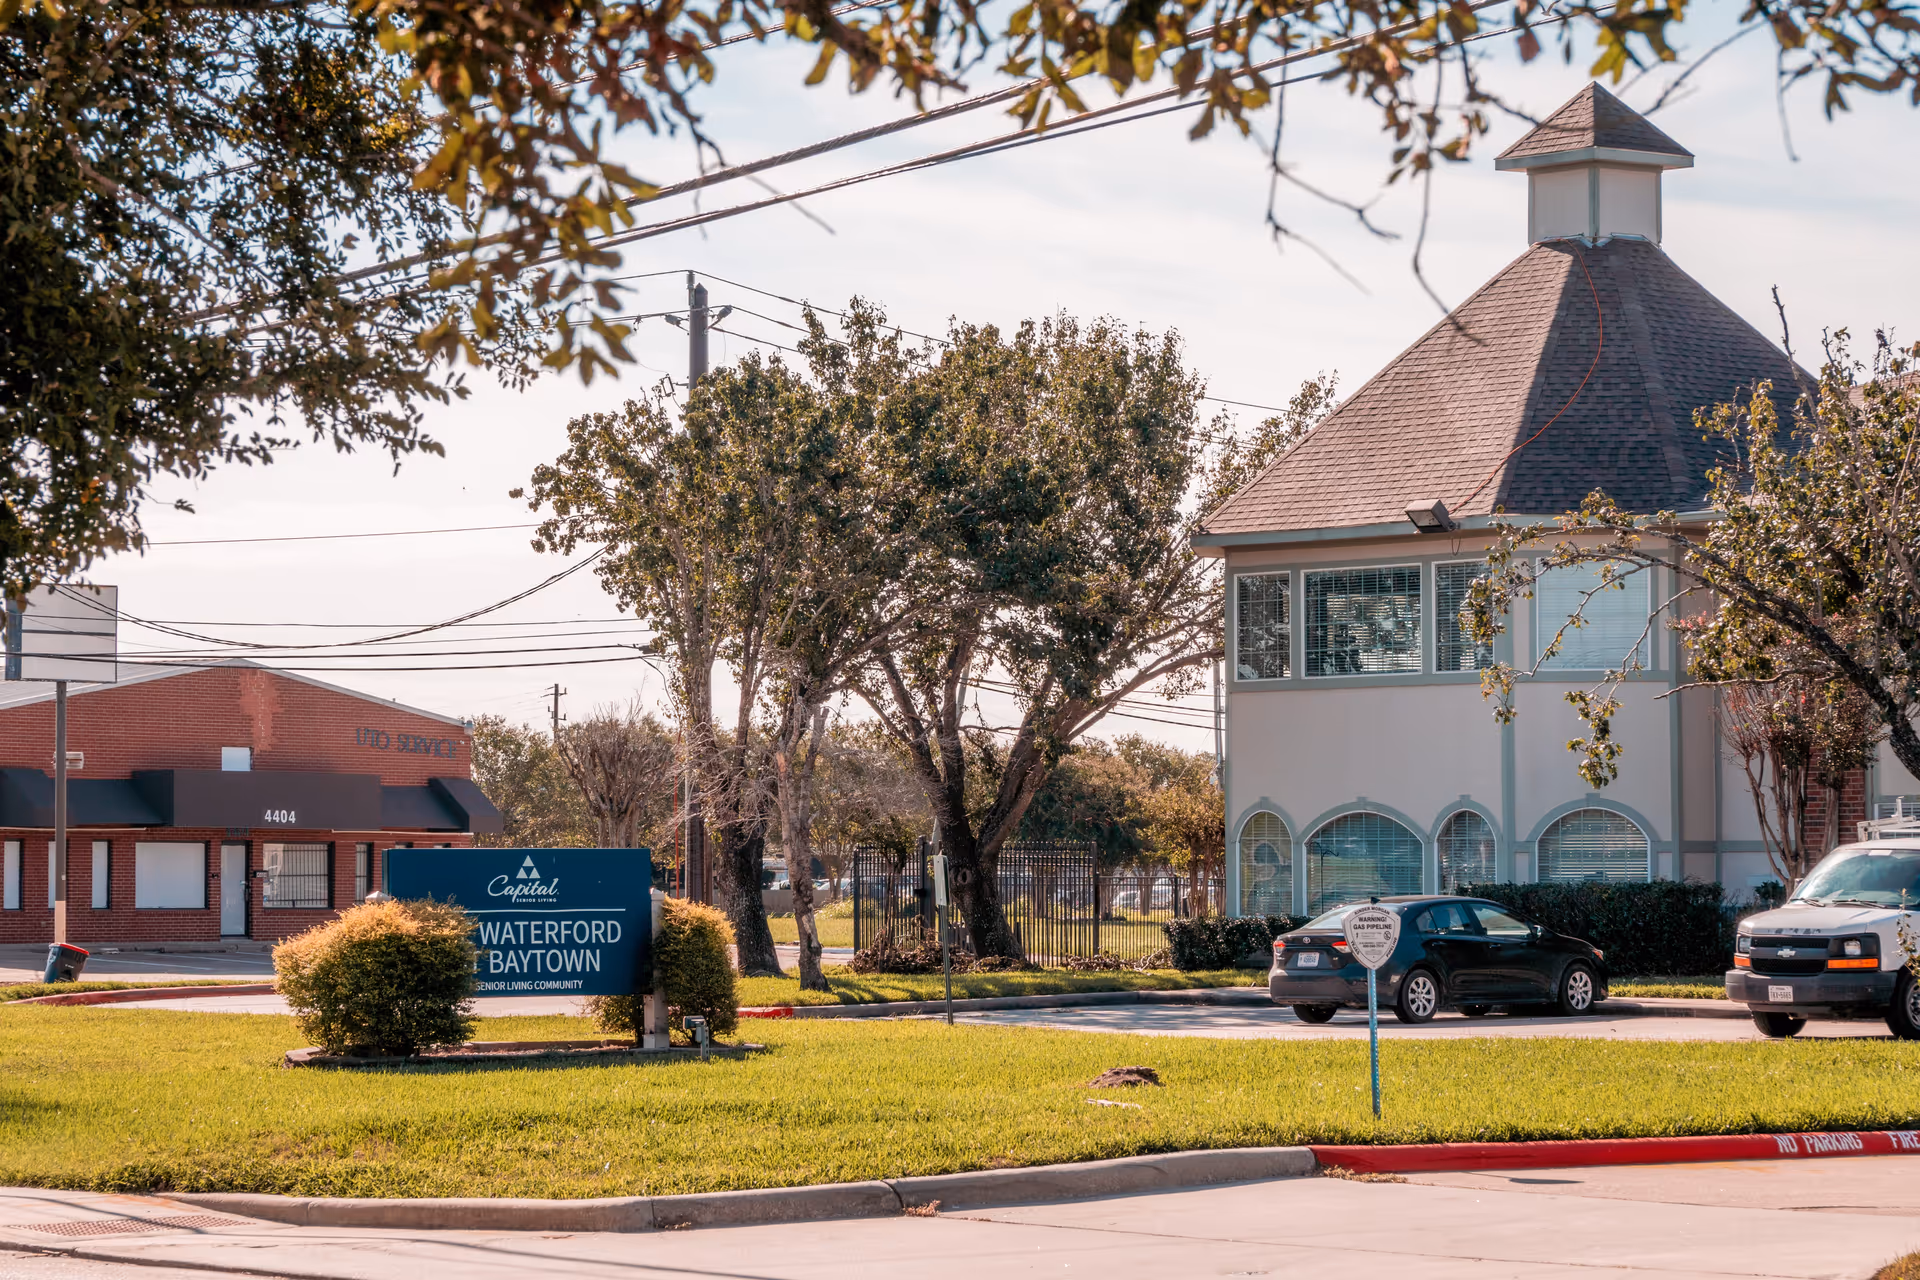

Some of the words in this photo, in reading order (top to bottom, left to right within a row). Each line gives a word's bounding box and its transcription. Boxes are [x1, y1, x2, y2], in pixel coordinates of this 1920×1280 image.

[398, 734, 457, 759] SERVICE
[264, 809, 296, 824] 4404
[487, 874, 559, 903] Capital
[1371, 906, 1390, 915] MORGAN
[479, 920, 622, 945] WATERFORD
[489, 949, 600, 974] BAYTOWN
[475, 981, 506, 991] SENIOR
[507, 980, 533, 990] LIVING
[534, 979, 583, 990] COMMUNITY
[1773, 1135, 1798, 1153] NO
[1802, 1132, 1863, 1154] PARKING
[1886, 1131, 1920, 1149] FIRE
